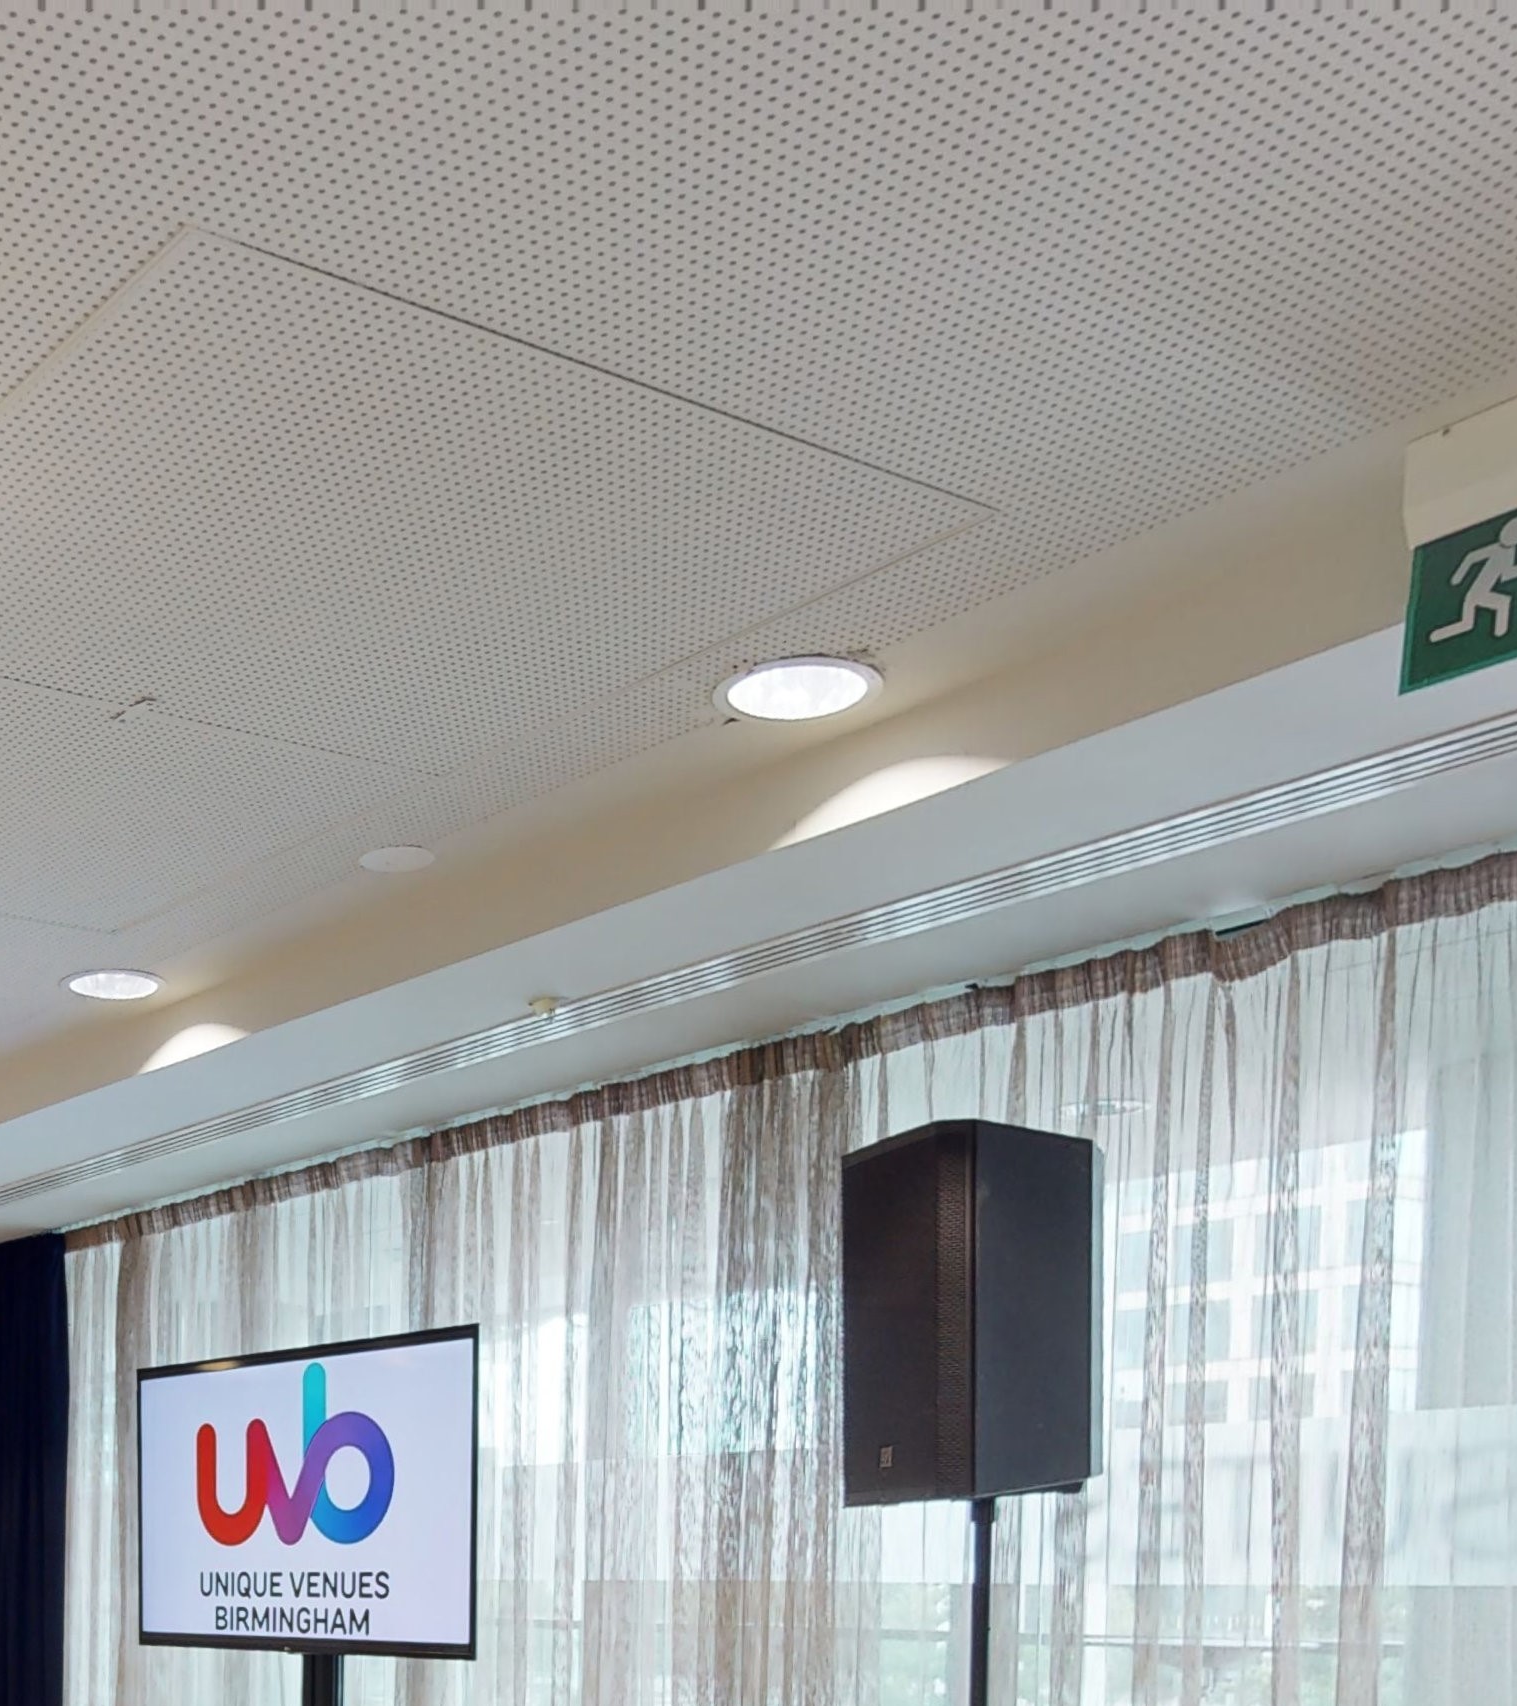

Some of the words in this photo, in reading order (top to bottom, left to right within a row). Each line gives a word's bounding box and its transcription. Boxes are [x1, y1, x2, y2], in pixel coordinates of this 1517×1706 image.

[200, 1571, 283, 1599] UNIQUE
[289, 1571, 390, 1599] VENUES
[215, 1605, 370, 1636] BIRMINGHAM
